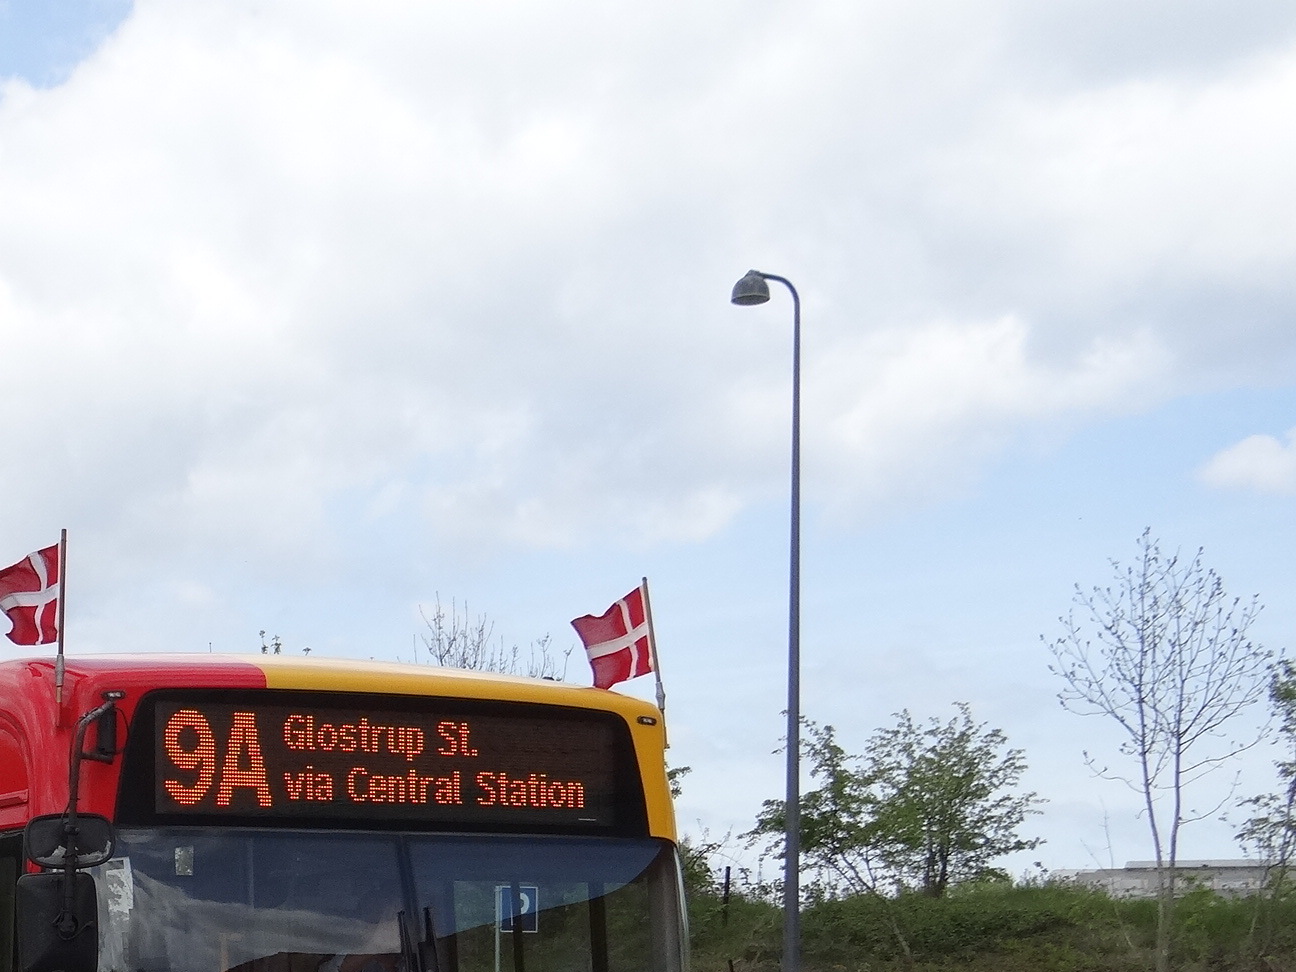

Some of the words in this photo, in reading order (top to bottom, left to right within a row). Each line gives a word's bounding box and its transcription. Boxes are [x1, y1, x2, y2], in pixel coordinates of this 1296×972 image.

[164, 709, 273, 807] 9A
[283, 714, 424, 762] Glostrup
[437, 721, 478, 757] St.
[283, 765, 334, 801] via
[347, 767, 463, 806] Central
[476, 770, 585, 809] Station
